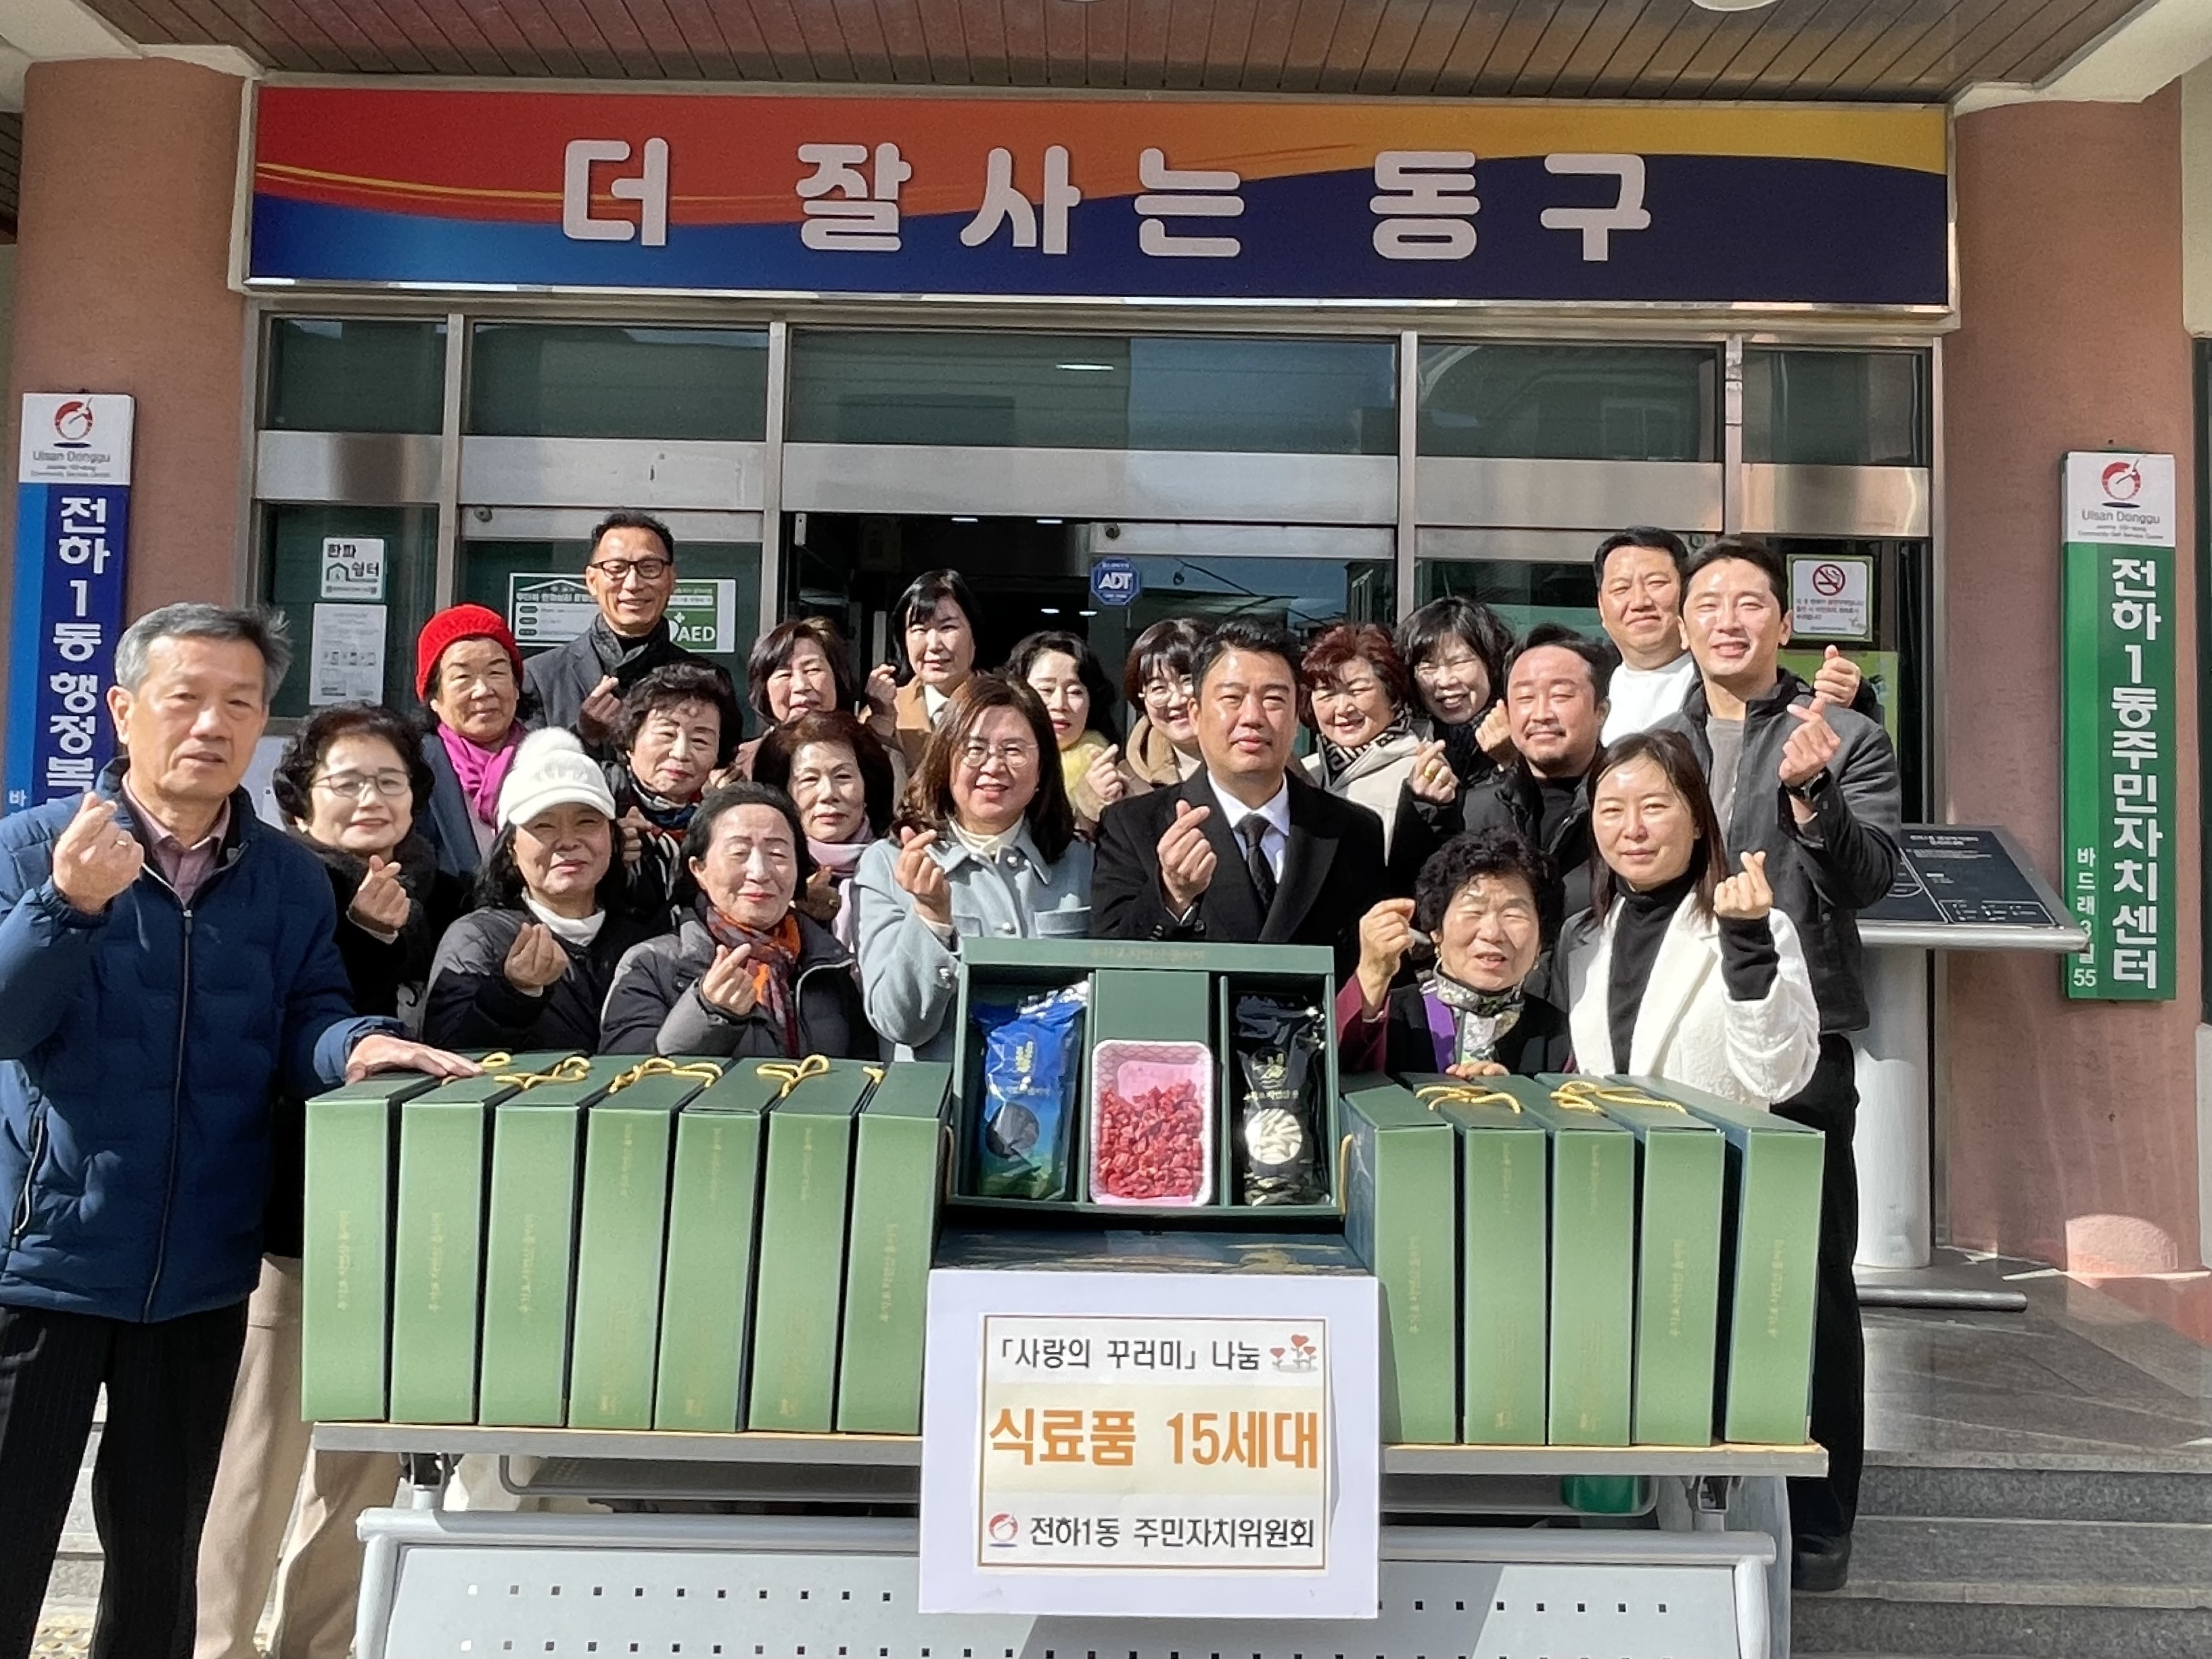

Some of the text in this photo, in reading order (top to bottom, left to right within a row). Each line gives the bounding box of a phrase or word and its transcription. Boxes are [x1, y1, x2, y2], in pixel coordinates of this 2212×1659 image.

[563, 137, 1651, 261] 더 잘사는 동구
[33, 450, 110, 464] Ulsan Donggu
[2081, 509, 2161, 525] Ulsan Donggu
[352, 561, 379, 577] 쉼터
[1098, 572, 1133, 589] ADT
[678, 625, 716, 641] AED
[2073, 968, 2096, 987] 55
[1002, 1338, 1260, 1370] 「사랑의 꾸러미」 나눔
[989, 1409, 1318, 1468] 식료품 15세대
[1030, 1517, 1314, 1548] 전하1동 주민자치위원회
